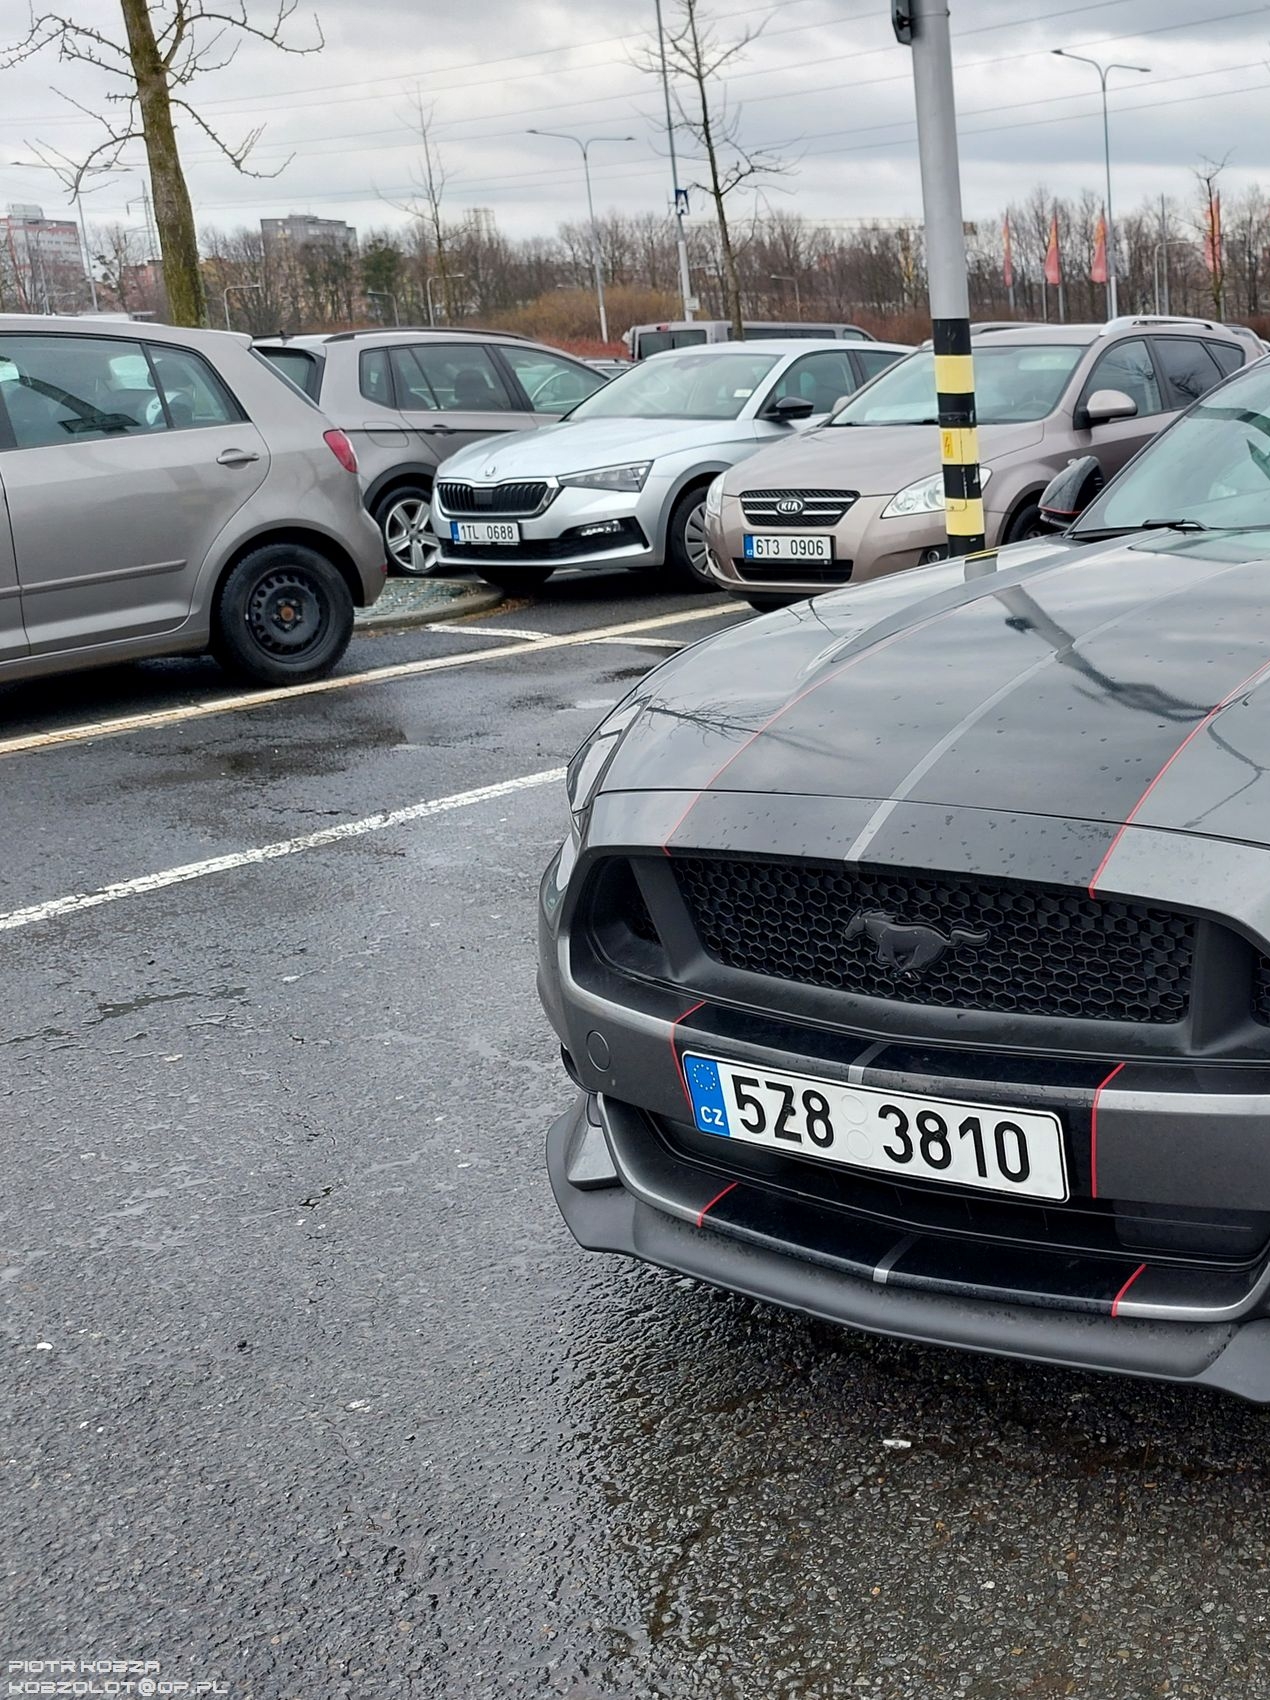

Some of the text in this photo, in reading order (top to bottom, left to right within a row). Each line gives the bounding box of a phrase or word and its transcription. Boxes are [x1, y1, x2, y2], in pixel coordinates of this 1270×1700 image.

[780, 502, 798, 511] KIA
[461, 525, 514, 540] 1TL 0688
[756, 538, 824, 556] 6T3 0906
[700, 1105, 725, 1127] CZ
[731, 1074, 1030, 1182] 5Z8 3810
